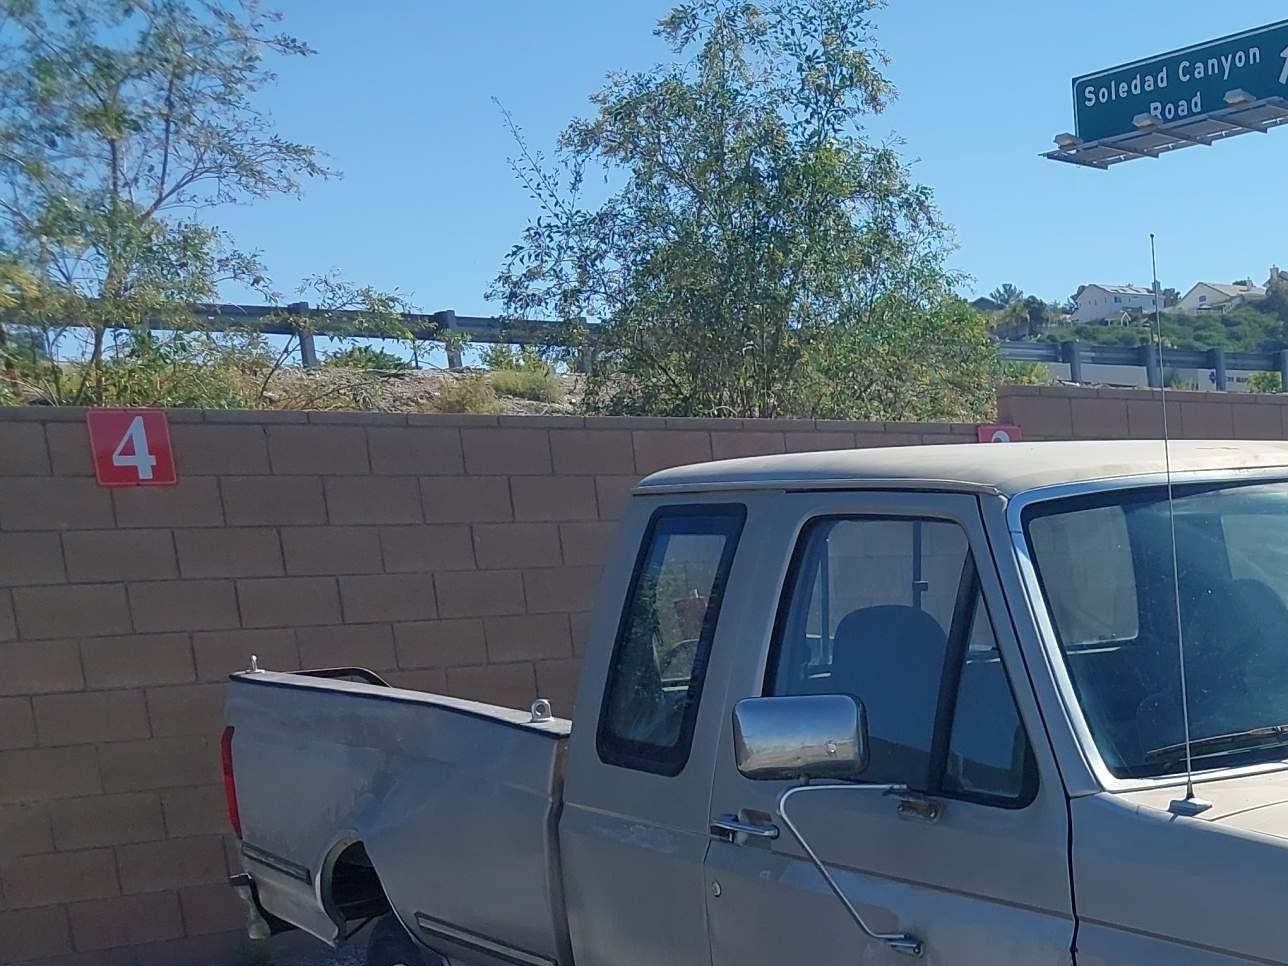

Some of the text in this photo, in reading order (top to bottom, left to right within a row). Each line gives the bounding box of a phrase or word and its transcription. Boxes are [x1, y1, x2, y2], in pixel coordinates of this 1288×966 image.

[1084, 47, 1260, 107] Soledad Canyon
[1150, 91, 1201, 121] Road
[112, 415, 157, 480] 4
